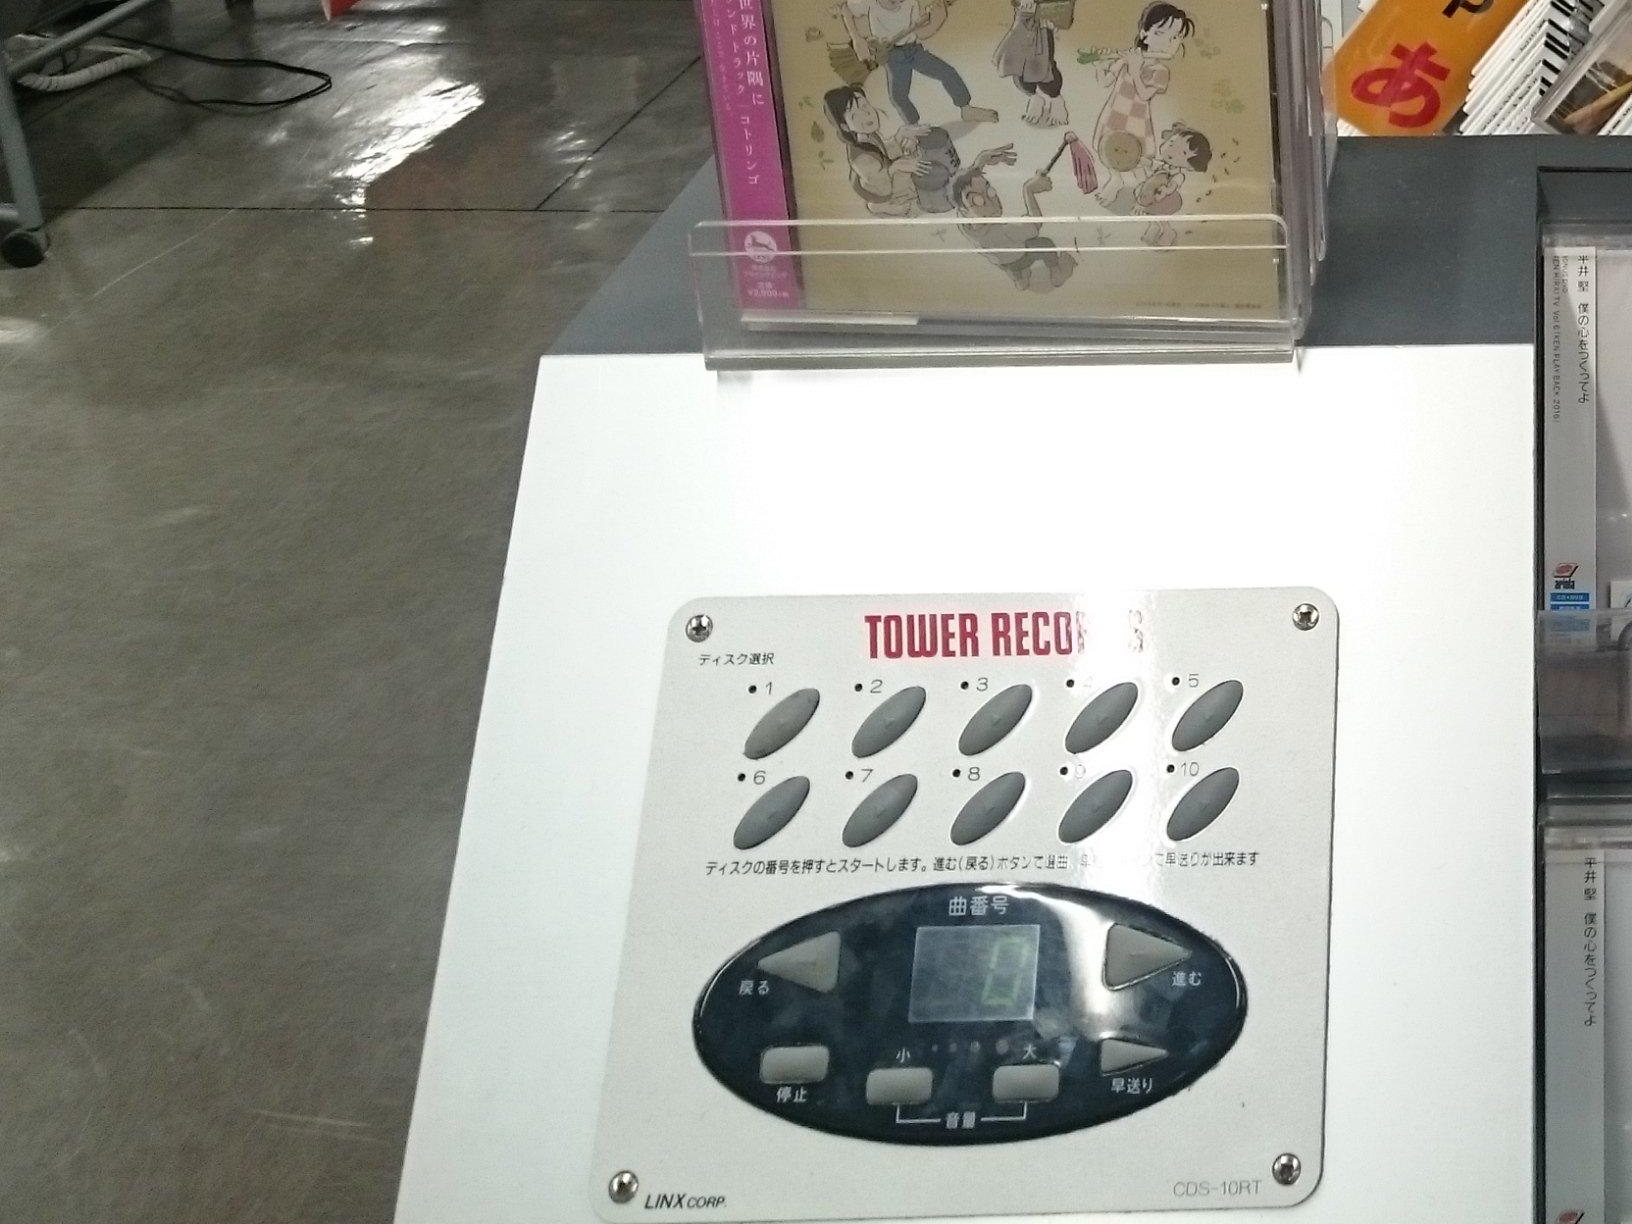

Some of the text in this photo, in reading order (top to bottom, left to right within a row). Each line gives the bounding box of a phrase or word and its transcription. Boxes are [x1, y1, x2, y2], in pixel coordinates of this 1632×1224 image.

[1351, 41, 1450, 129] あ
[864, 612, 980, 659] TOWER
[698, 651, 775, 667] ディスク選択
[765, 681, 773, 696] 1
[869, 680, 883, 694] 2
[976, 678, 989, 692] 3
[1188, 674, 1200, 689] 5
[753, 770, 766, 784] 6
[861, 769, 874, 784] 7
[968, 767, 981, 781] 8
[1180, 762, 1200, 777] 10
[948, 895, 1009, 917] 曲番号
[1584, 912, 1597, 1026] 僕の心をつくってよ
[738, 980, 771, 996] 戻る
[1171, 971, 1202, 987] 進む
[895, 1047, 911, 1062] 小
[1022, 1043, 1037, 1060] 大
[1111, 1076, 1154, 1095] 早送り
[776, 1087, 808, 1104] 停止
[946, 1111, 977, 1130] 音量
[1173, 1179, 1264, 1198] CDS-10RT
[644, 1193, 685, 1210] LINX
